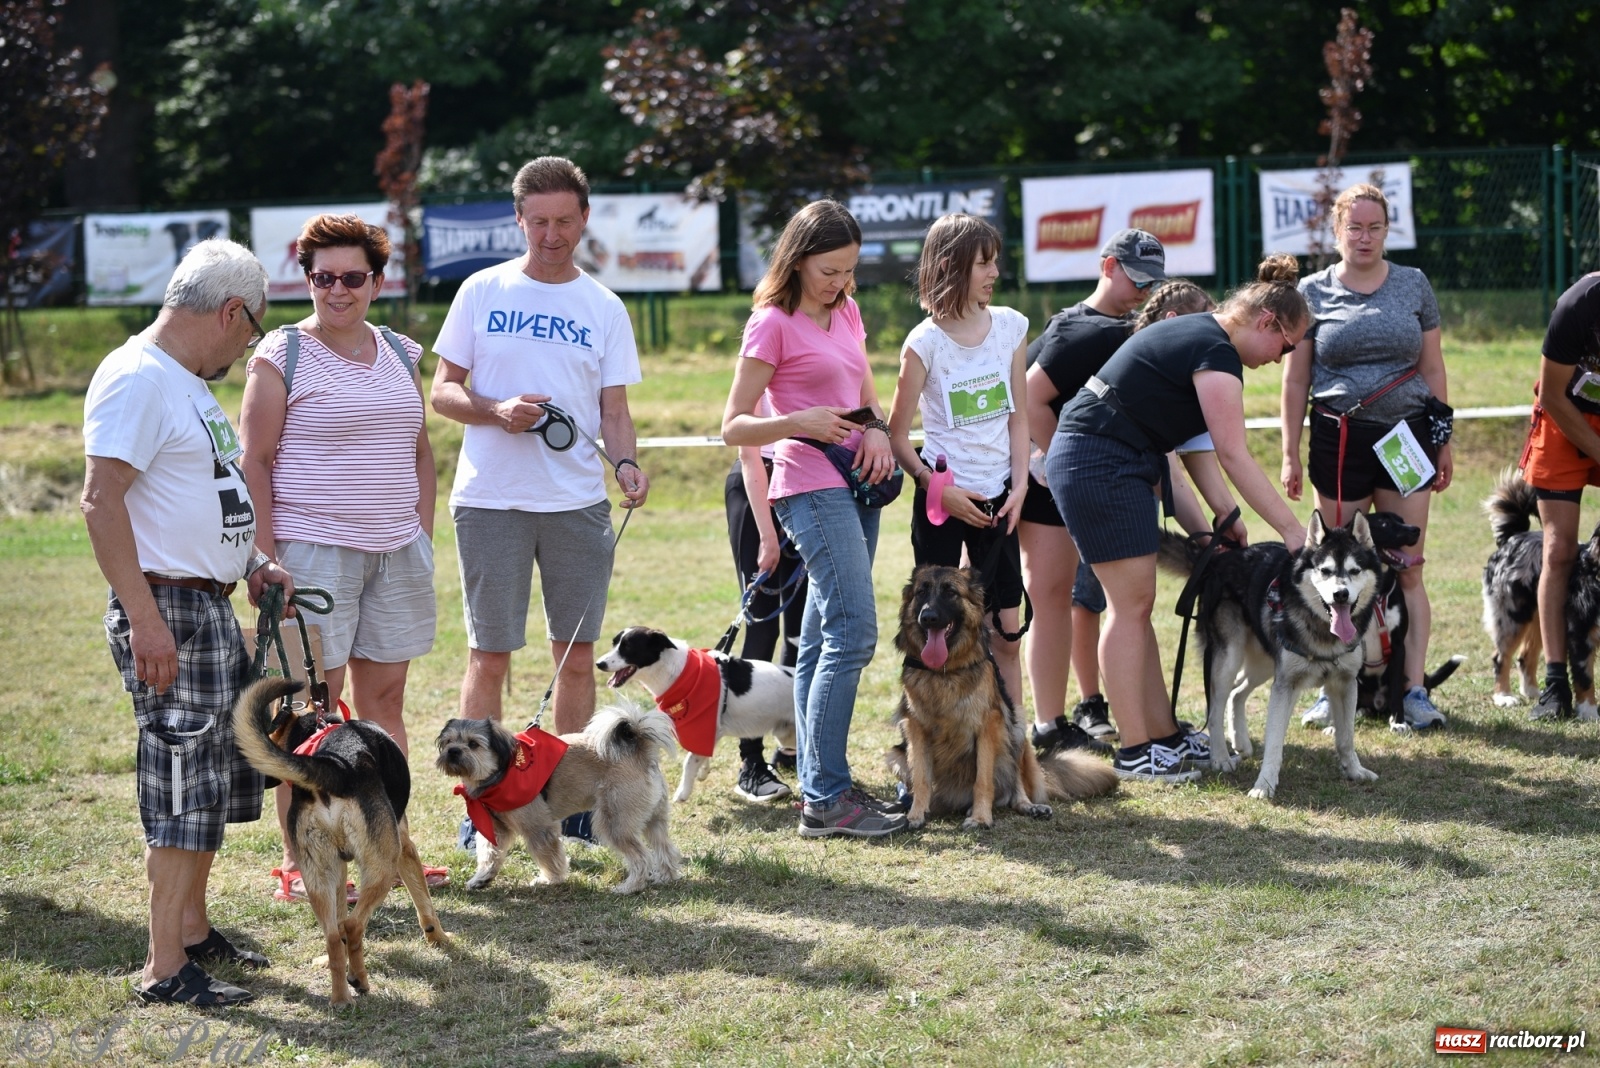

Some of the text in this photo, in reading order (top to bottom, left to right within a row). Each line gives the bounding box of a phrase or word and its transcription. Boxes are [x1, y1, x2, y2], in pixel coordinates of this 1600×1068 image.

[849, 187, 996, 223] FRONTLINE
[487, 310, 593, 348] DIVERSE
[951, 371, 1000, 390] DOGTREKKING
[977, 394, 988, 410] 6
[1391, 455, 1410, 476] 32
